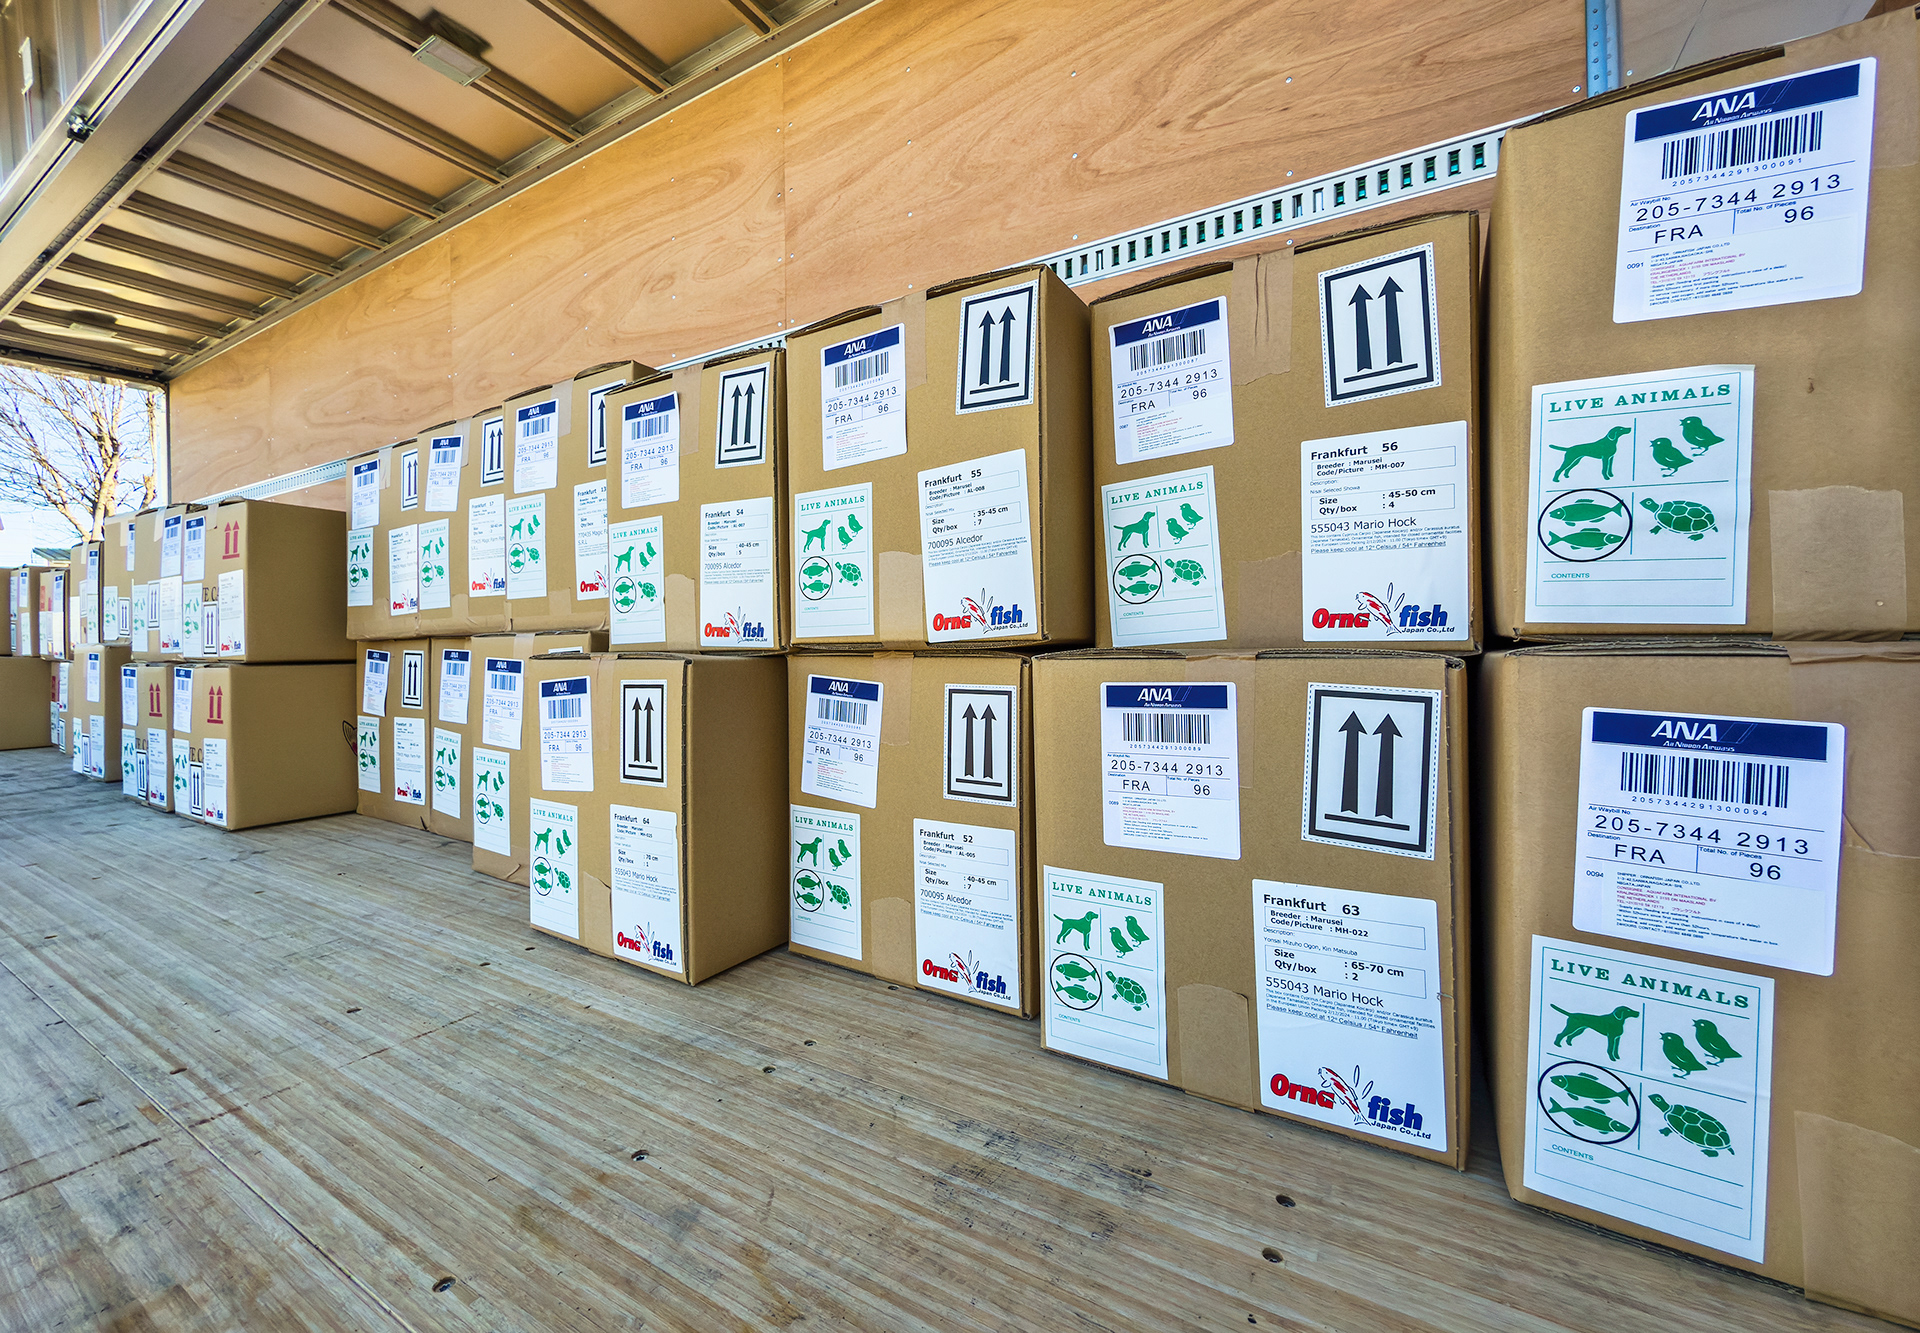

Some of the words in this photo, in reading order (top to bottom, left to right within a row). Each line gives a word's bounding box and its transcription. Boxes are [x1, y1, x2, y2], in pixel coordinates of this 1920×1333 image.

[1692, 92, 1756, 121] ANA
[1672, 158, 1802, 187] 2057344291300091
[1636, 189, 1757, 222] 205-7344
[1773, 175, 1841, 198] 2913
[1774, 200, 1796, 208] Pieces
[1784, 206, 1814, 223] 96
[1629, 224, 1661, 232] Destination
[1654, 225, 1703, 244] FRA
[1142, 315, 1173, 334] ANA
[844, 340, 866, 355] ANA
[1121, 378, 1179, 398] 205-7344
[1186, 369, 1218, 383] 2913
[828, 394, 869, 412] 205-7344
[874, 387, 897, 400] 2913
[1193, 388, 1207, 400] 96
[1549, 398, 1604, 413] LIVE
[1615, 384, 1731, 406] ANIMALS
[528, 407, 540, 416] ANA
[638, 402, 654, 414] ANA
[878, 404, 889, 413] 96
[1131, 400, 1155, 413] FRA
[835, 414, 853, 424] FRA
[626, 448, 656, 460] 205-7344
[657, 444, 674, 453] 2913
[1311, 445, 1368, 460] Frankfurt
[1382, 442, 1398, 452] 56
[630, 462, 643, 471] FRA
[660, 457, 668, 466] 96
[1317, 461, 1344, 470] Breeder
[1353, 457, 1383, 466] Marusei
[1317, 466, 1364, 476] Code/Picture
[1375, 462, 1405, 470] MH-007
[924, 473, 962, 488] Frankfurt
[971, 469, 982, 478] 55
[578, 488, 597, 497] Frankfurt
[1111, 492, 1140, 504] LIVE
[1145, 481, 1204, 499] ANIMALS
[1319, 497, 1338, 505] Size
[1388, 488, 1417, 498] 45-50
[508, 505, 520, 513] LIVE
[521, 502, 542, 510] ANIMALS
[801, 502, 821, 511] LIVE
[824, 496, 865, 508] ANIMALS
[1319, 505, 1357, 515] Qty/box
[705, 510, 730, 519] Frankfurt
[977, 507, 997, 517] 35-45
[613, 531, 628, 539] LIVE
[630, 526, 658, 536] ANIMALS
[932, 524, 958, 534] Qty/box
[1311, 522, 1349, 533] 555043
[1354, 520, 1384, 530] Mario
[1388, 517, 1416, 528] Hock
[928, 538, 954, 550] 700095
[956, 535, 983, 545] Alcedor
[990, 604, 1023, 625] fish
[1399, 605, 1447, 627] fish
[553, 683, 567, 693] ANA
[828, 681, 849, 692] ANA
[1137, 688, 1172, 701] ANA
[572, 730, 587, 738] 2913
[1651, 720, 1718, 742] ANA
[810, 731, 847, 743] 205-7344
[851, 738, 872, 748] 2913
[548, 744, 560, 752] FRA
[815, 746, 831, 755] FRA
[854, 753, 863, 762] 96
[1111, 760, 1178, 773] 205-7344
[1186, 764, 1223, 776] 2913
[1122, 780, 1150, 791] FRA
[1194, 785, 1210, 795] 96
[1600, 806, 1620, 814] Waybill
[1632, 795, 1767, 816] 2057344291300094
[533, 809, 546, 817] LIVE
[548, 812, 573, 822] ANIMALS
[614, 813, 638, 823] Frankfurt
[643, 817, 650, 825] 64
[795, 816, 813, 825] LIVE
[817, 819, 853, 831] ANIMALS
[919, 829, 954, 841] Frankfurt
[963, 835, 973, 843] 52
[1587, 832, 1621, 841] Destination
[1595, 815, 1721, 844] 205-7344
[1737, 832, 1809, 854] 2913
[1615, 844, 1665, 864] FRA
[1739, 851, 1762, 859] Pieces
[1586, 870, 1603, 878] 0094
[1750, 863, 1781, 879] 96
[925, 876, 949, 886] Qty/box
[967, 875, 986, 885] 40-45
[920, 889, 945, 900] 700095
[946, 894, 972, 905] Alcedor
[1052, 882, 1083, 894] LIVE
[1089, 888, 1152, 906] ANIMALS
[1264, 894, 1326, 911] Frankfurt
[1342, 905, 1360, 915] 63
[1270, 910, 1301, 919] Breeder
[1311, 916, 1343, 926] Marusei
[1271, 918, 1323, 930] Code/Picture
[1335, 927, 1368, 937] MH-022
[1282, 939, 1302, 947] Mizuho
[1333, 947, 1357, 956] Matsuba
[1274, 949, 1295, 959] Size
[1351, 962, 1384, 973] 65-70
[1387, 968, 1404, 977] cm
[1274, 960, 1316, 974] Qty/box
[1352, 973, 1358, 981] 2
[976, 971, 1006, 995] fish
[1551, 958, 1610, 981] LIVE
[1621, 974, 1748, 1008] ANIMALS
[1266, 977, 1309, 993] 555043
[1313, 985, 1347, 1000] Mario
[1352, 992, 1384, 1007] Hock
[1058, 1014, 1080, 1022] CONTENTS
[1368, 1096, 1423, 1130] fish
[1371, 1121, 1397, 1131] Japan
[1552, 1144, 1594, 1161] CONTENTS
